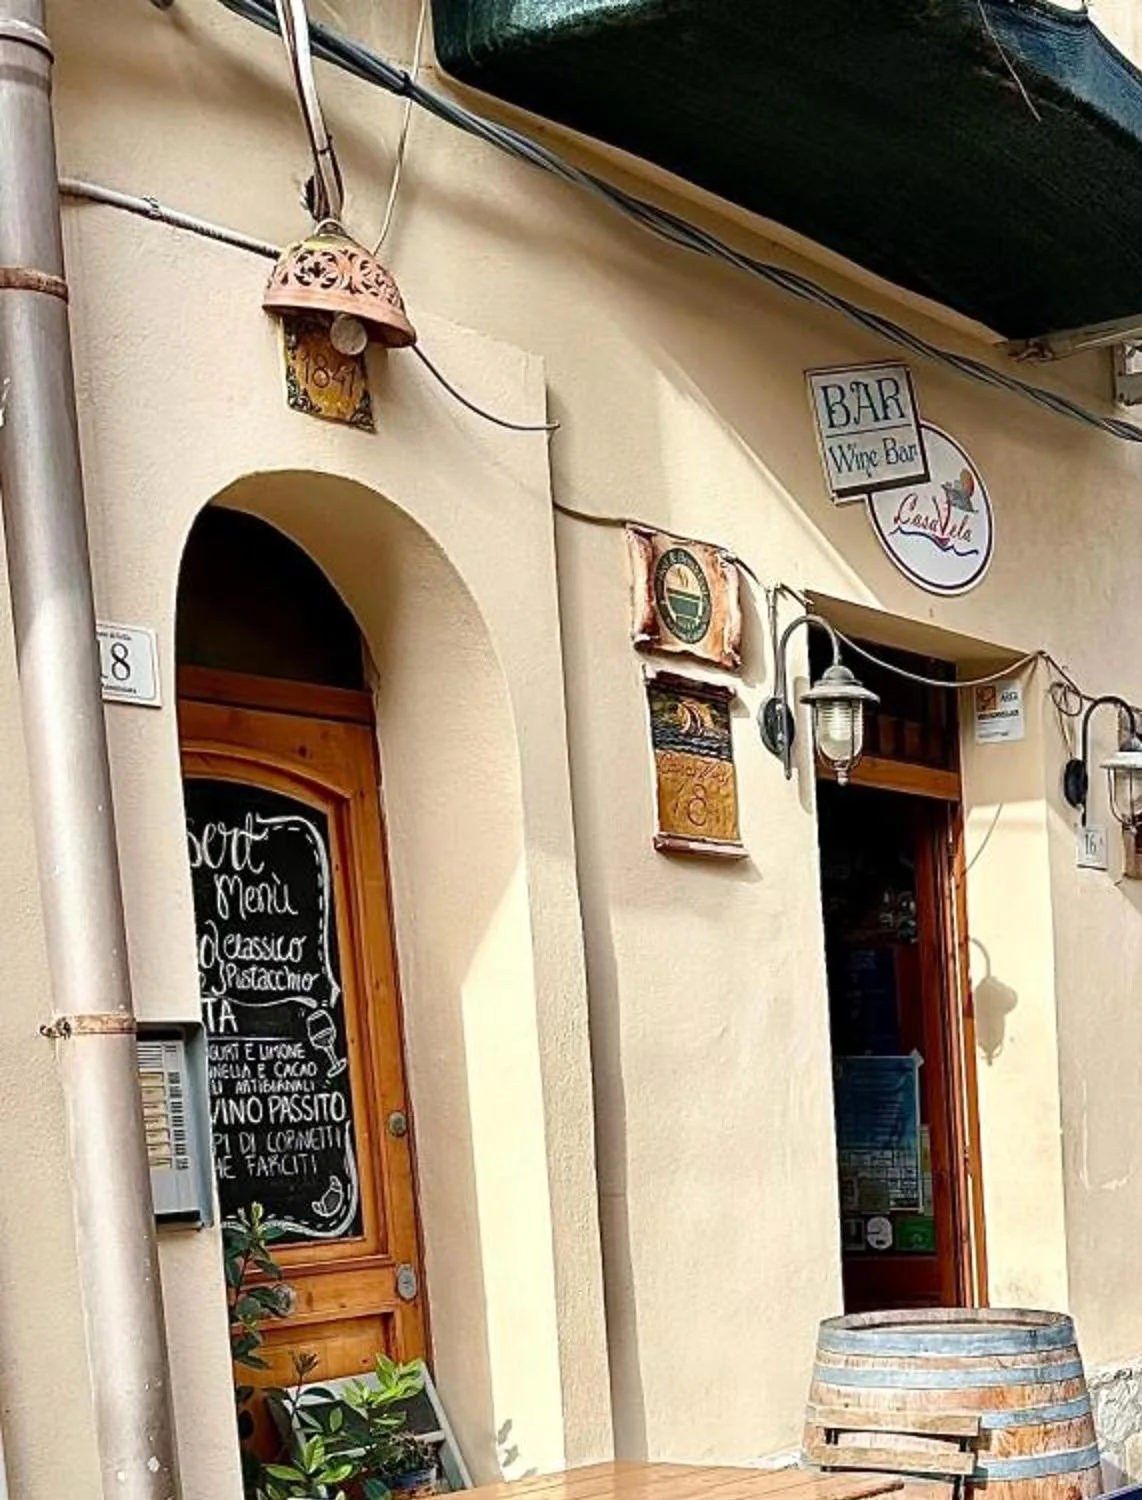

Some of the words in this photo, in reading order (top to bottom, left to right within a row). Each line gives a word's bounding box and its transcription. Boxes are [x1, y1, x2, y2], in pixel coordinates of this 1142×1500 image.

[821, 377, 905, 428] BAR
[828, 442, 879, 478] Wine
[882, 437, 918, 465] Bar
[244, 1043, 257, 1061] E
[258, 1042, 306, 1061] LIMONE
[256, 1063, 266, 1079] E
[273, 1060, 318, 1079] CACAO
[267, 1091, 347, 1124] PASSITO
[239, 1131, 256, 1155] DI
[266, 1125, 342, 1154] CORNETTI
[244, 1153, 318, 1177] FARCITI
